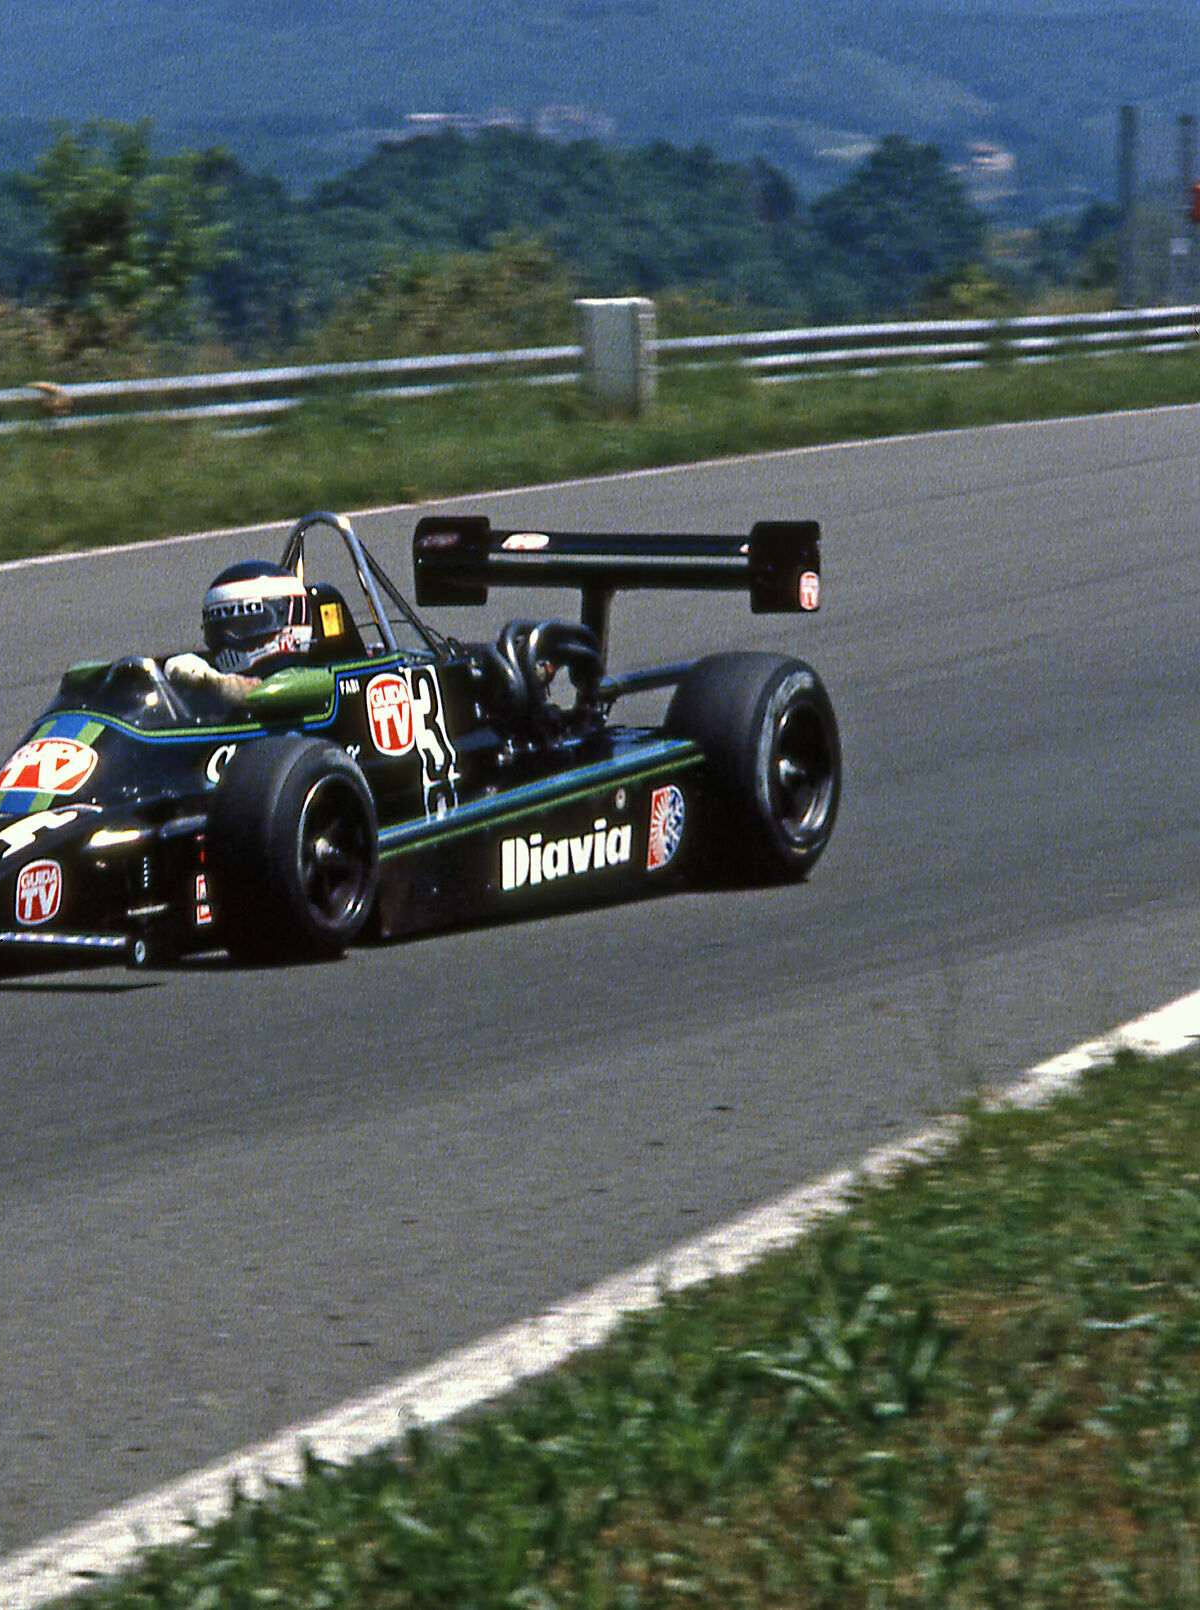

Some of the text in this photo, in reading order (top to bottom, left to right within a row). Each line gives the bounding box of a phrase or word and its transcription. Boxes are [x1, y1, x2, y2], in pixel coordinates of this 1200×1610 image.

[370, 683, 410, 709] GUIDA
[372, 703, 411, 748] TV
[0, 756, 93, 788] TV
[501, 817, 632, 892] Diavia
[20, 868, 58, 888] GUIDA
[20, 882, 58, 919] TV
